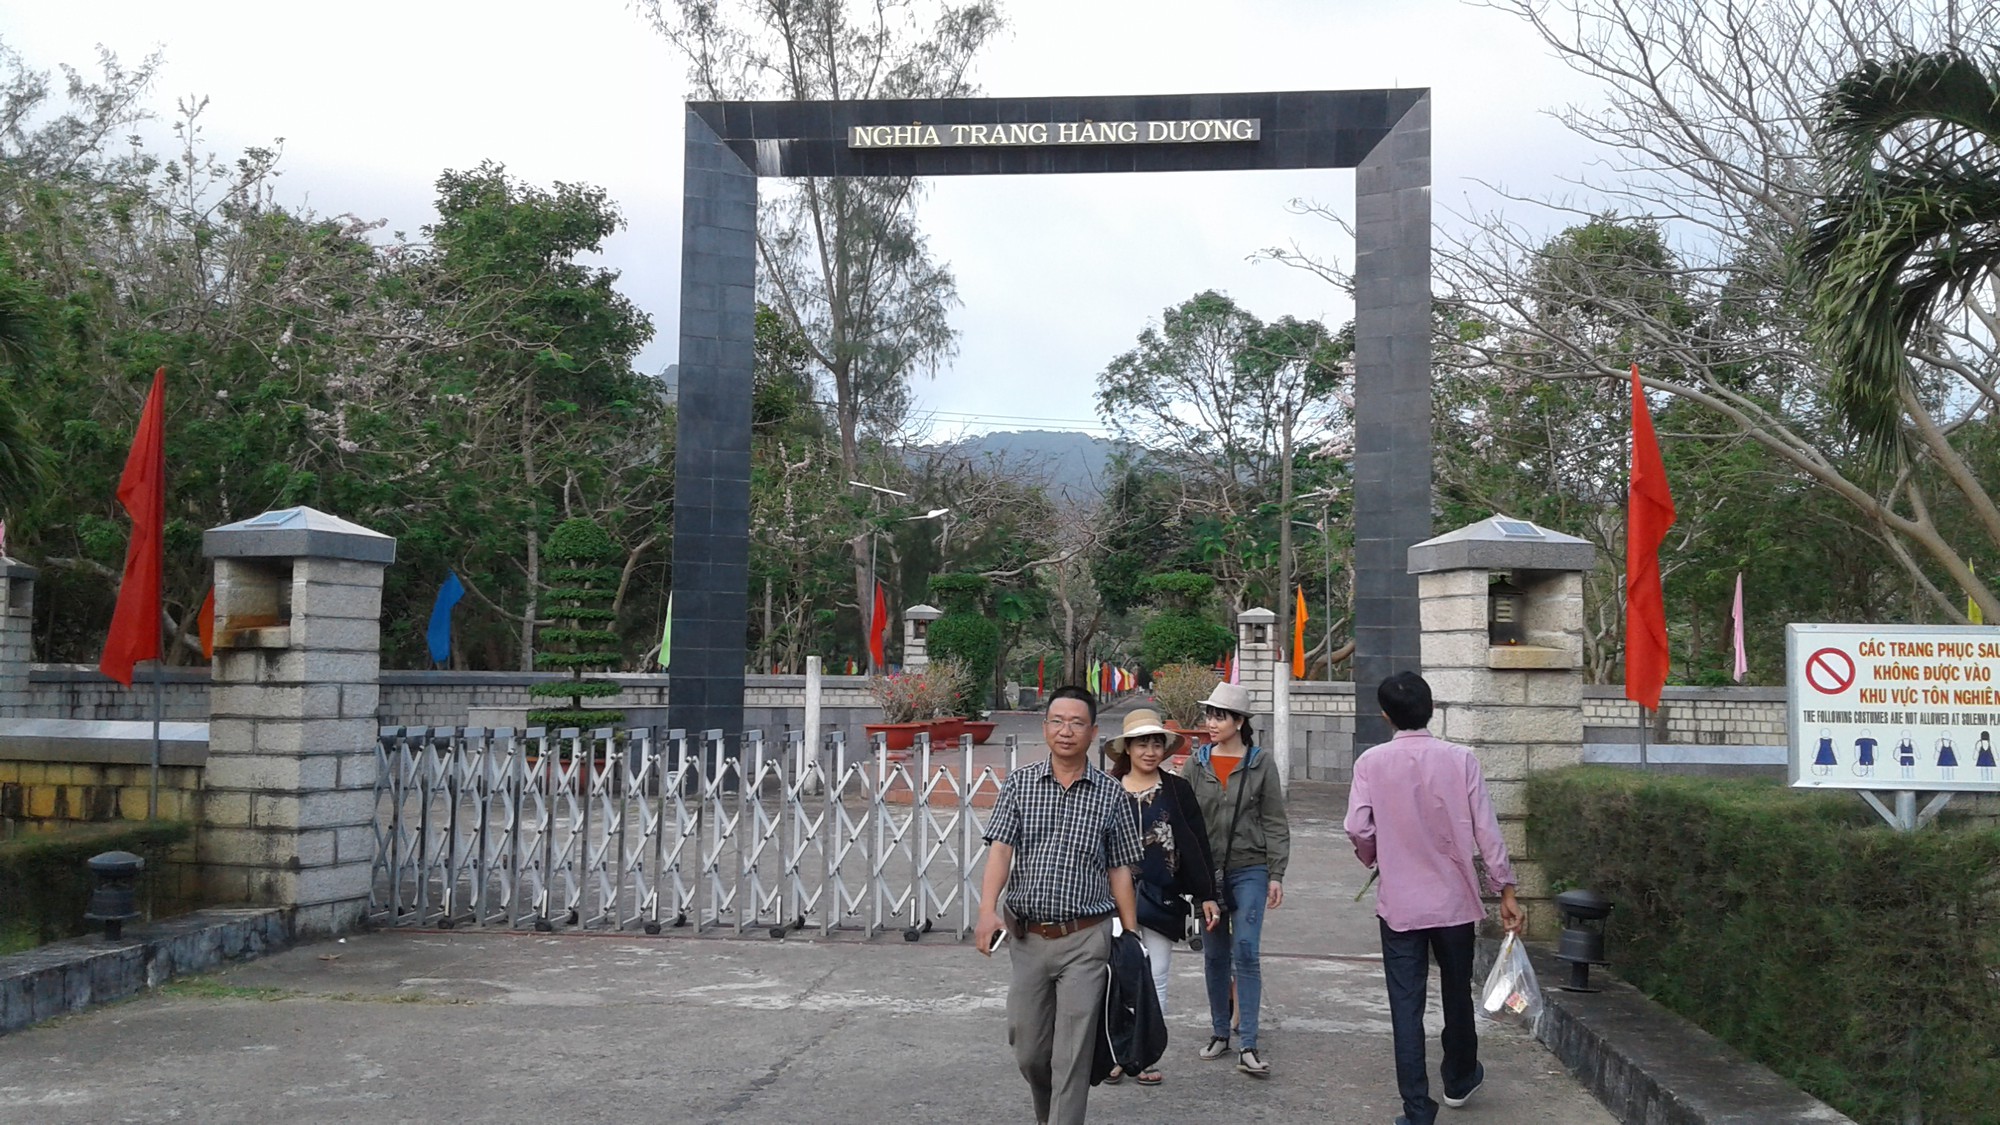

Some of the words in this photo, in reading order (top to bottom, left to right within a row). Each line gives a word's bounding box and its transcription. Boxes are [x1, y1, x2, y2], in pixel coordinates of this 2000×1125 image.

[854, 121, 941, 146] NGHĨA
[951, 124, 1048, 145] TRANG
[1147, 120, 1254, 141] DƯƠNG
[1859, 638, 1885, 656] CÁC
[1889, 642, 1933, 657] TRANG
[1938, 643, 1974, 660] PHỤC
[1874, 662, 1919, 680] KHÔNG
[1924, 663, 1959, 683] ĐƯỢC
[1965, 662, 1991, 682] VÀO
[1860, 689, 1887, 703] KHU
[1892, 687, 1918, 707] VỰC
[1922, 686, 1949, 704] TÔN
[1803, 710, 1815, 722] THE
[1817, 711, 1852, 723] FOLLOWING
[1854, 712, 1888, 724] COSTUMES
[1890, 712, 1903, 724] ARE
[1905, 712, 1917, 724] NOT
[1920, 713, 1949, 725] ALLOWED
[1951, 713, 1960, 725] AT
